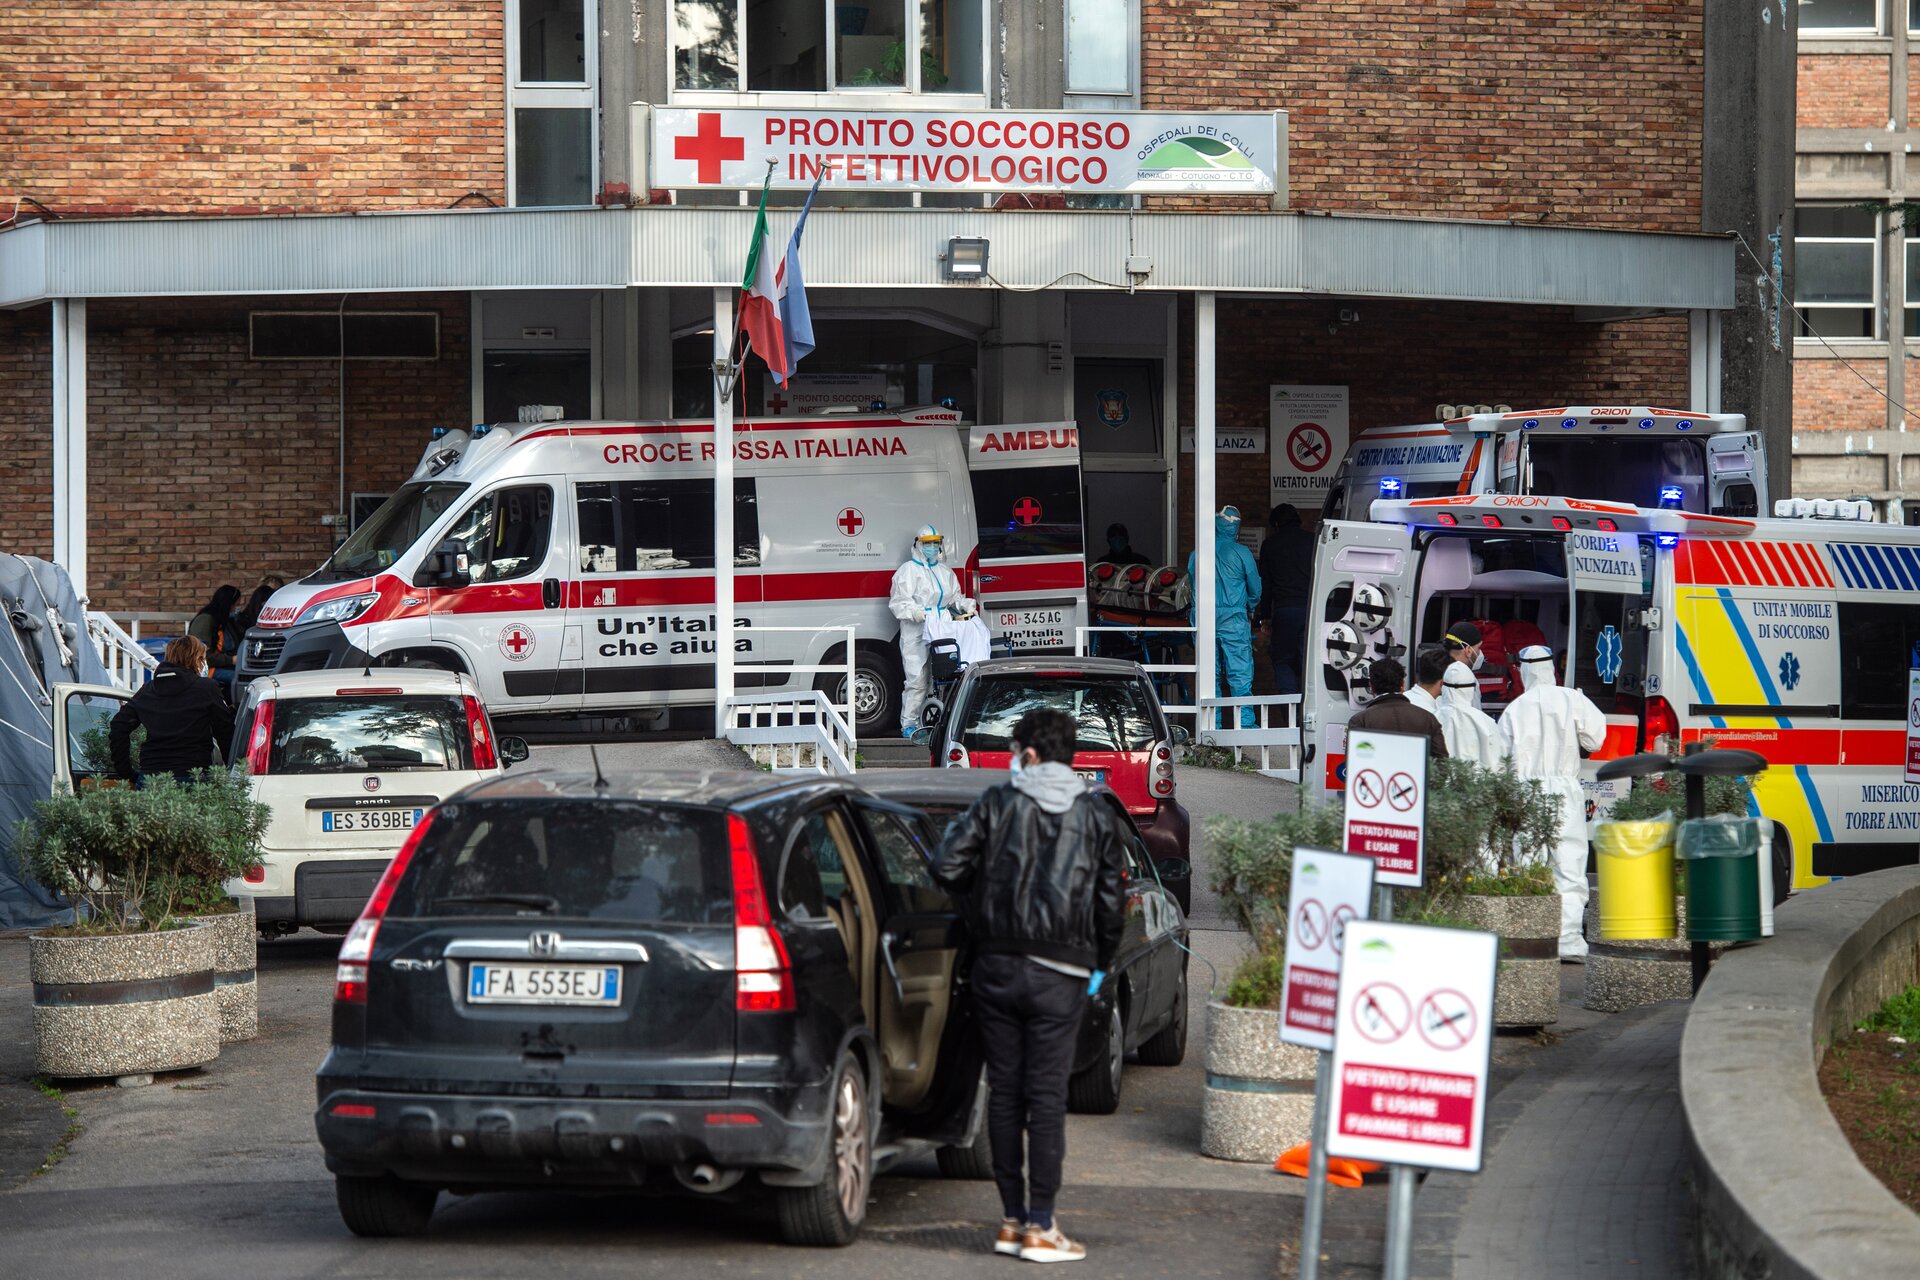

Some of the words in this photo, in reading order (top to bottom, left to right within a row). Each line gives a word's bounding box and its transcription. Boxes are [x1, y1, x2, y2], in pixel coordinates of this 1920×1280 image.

[765, 118, 915, 148] PRONTO
[926, 119, 1130, 150] SOCCORSO
[1137, 126, 1191, 160] OSPEDALI
[1197, 125, 1218, 137] DEI
[1222, 132, 1254, 159] COLLI
[788, 153, 1108, 184] INFETTIVOLOGICO
[793, 394, 830, 402] PRONTO
[832, 394, 884, 402] SOCCORSO
[1590, 408, 1632, 416] ORION
[603, 442, 693, 464] CROCE
[701, 440, 788, 461] RSSA
[795, 437, 907, 459] ITALIANA
[1191, 438, 1255, 449] LANZA
[1356, 449, 1382, 467] CENTRO
[1382, 447, 1406, 466] MOBILE
[1407, 446, 1416, 465] DI
[1415, 444, 1464, 465] RIANIMAZIONE
[1273, 476, 1308, 488] VIETATO
[1493, 496, 1550, 507] ORION
[1753, 602, 1788, 617] UNITA'
[1790, 603, 1832, 618] MOBILE
[597, 614, 752, 635] Un'Itala
[1000, 613, 1018, 626] CRI
[1003, 629, 1063, 639] Un'Italia
[1758, 623, 1770, 638] DI
[1773, 624, 1830, 640] SOCCORSO
[599, 639, 658, 657] che
[670, 636, 753, 654] aiua
[1031, 637, 1063, 647] aiuta
[1648, 677, 1658, 690] 14
[367, 779, 378, 787] FIAT
[1862, 785, 1920, 803] MISERICO
[334, 812, 354, 829] ES
[360, 811, 411, 828] 369BE
[1846, 812, 1886, 830] TORRE
[1350, 823, 1383, 837] VIETATO
[1384, 826, 1418, 841] FUMARE
[1365, 840, 1371, 850] E
[1372, 841, 1399, 854] USARE
[1386, 858, 1414, 870] LIBERE
[488, 969, 515, 995] FA
[527, 970, 602, 996] 553EJ
[1345, 1067, 1408, 1091] VIETATO
[1409, 1073, 1474, 1097] FUMARE
[1371, 1092, 1383, 1112] E
[1387, 1095, 1439, 1118] USARE
